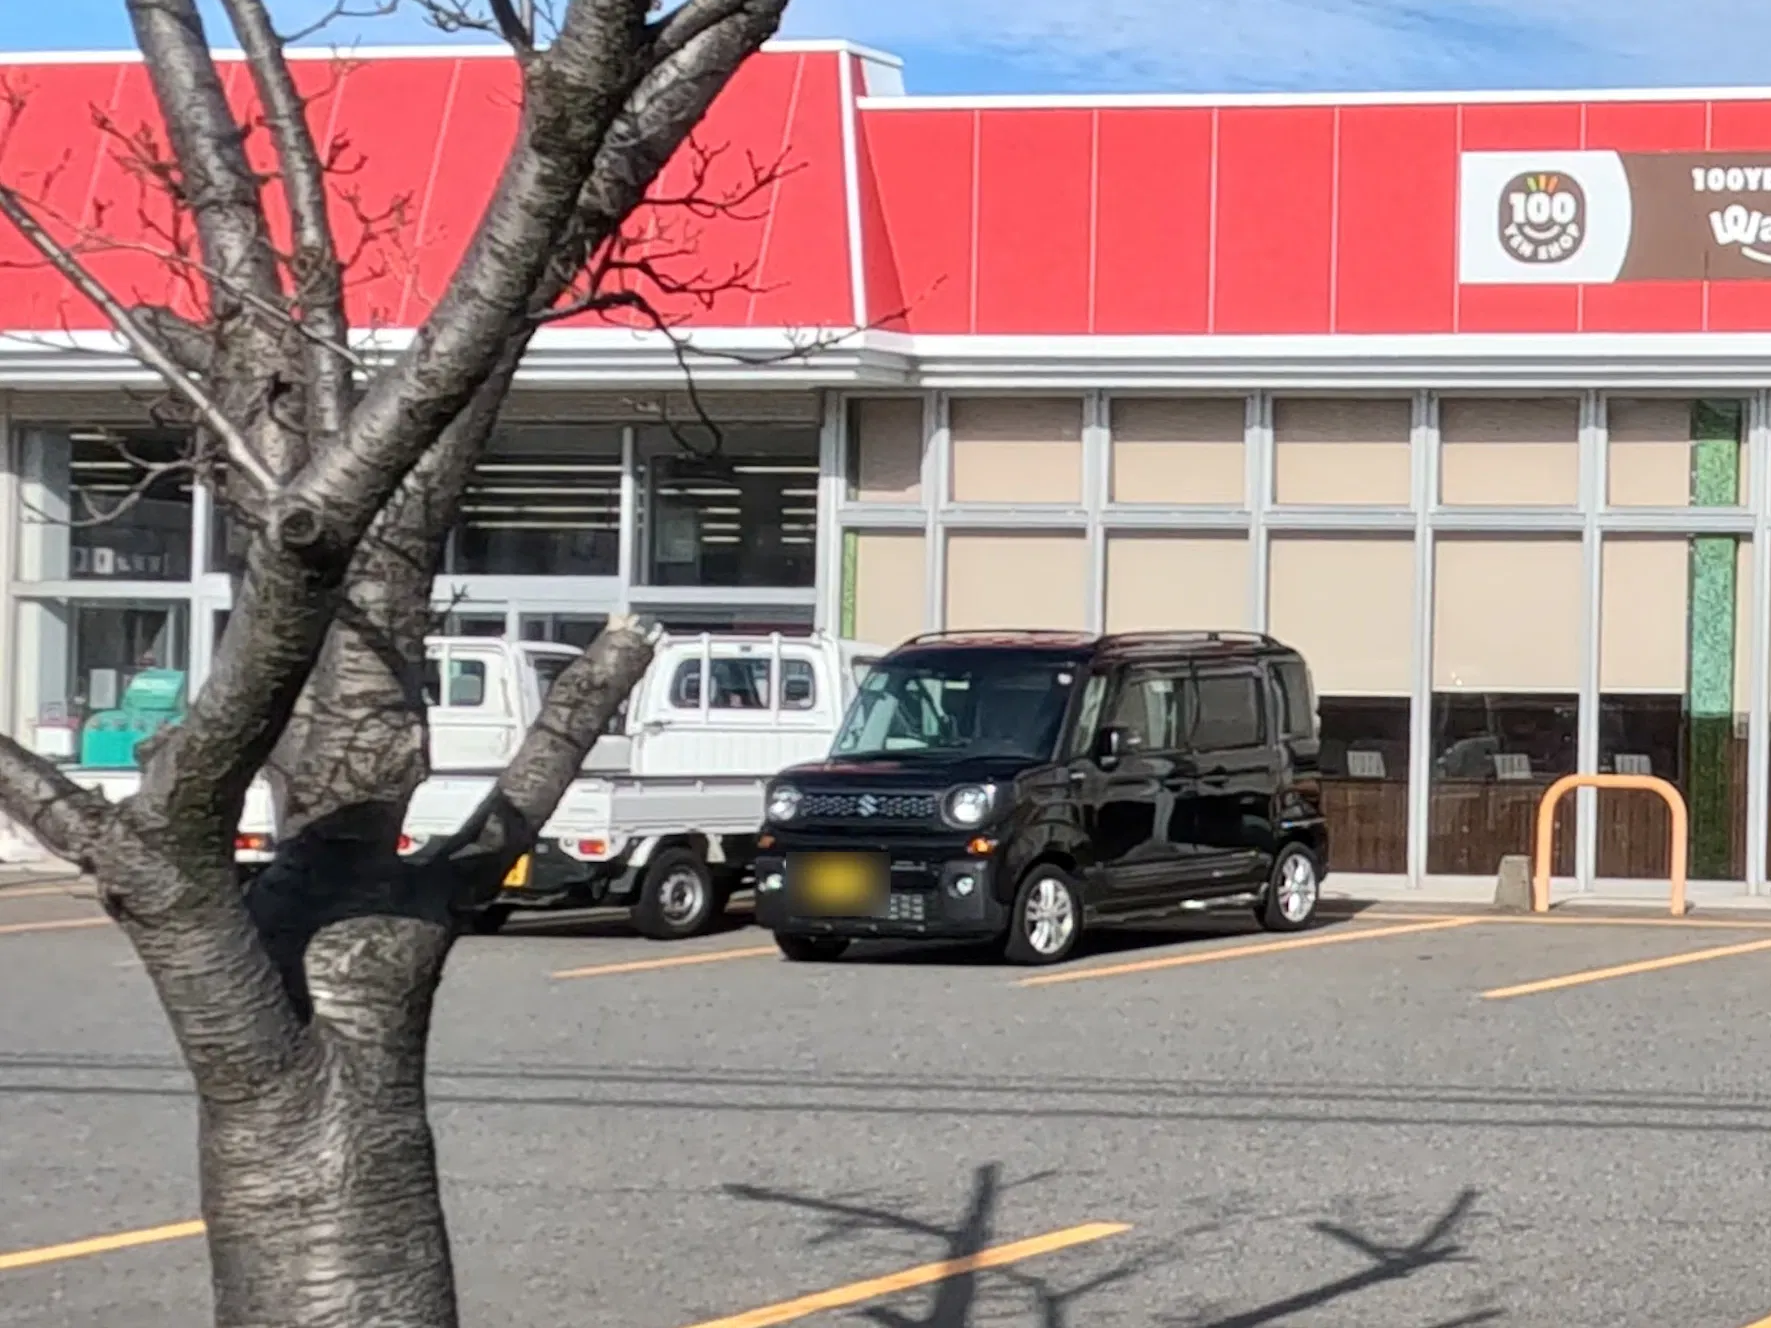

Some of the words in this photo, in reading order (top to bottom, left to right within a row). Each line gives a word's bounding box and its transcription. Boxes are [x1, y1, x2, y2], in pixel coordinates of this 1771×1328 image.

[1509, 192, 1576, 224] 100
[1503, 222, 1535, 258] YEN
[1537, 222, 1580, 260] SHOP
